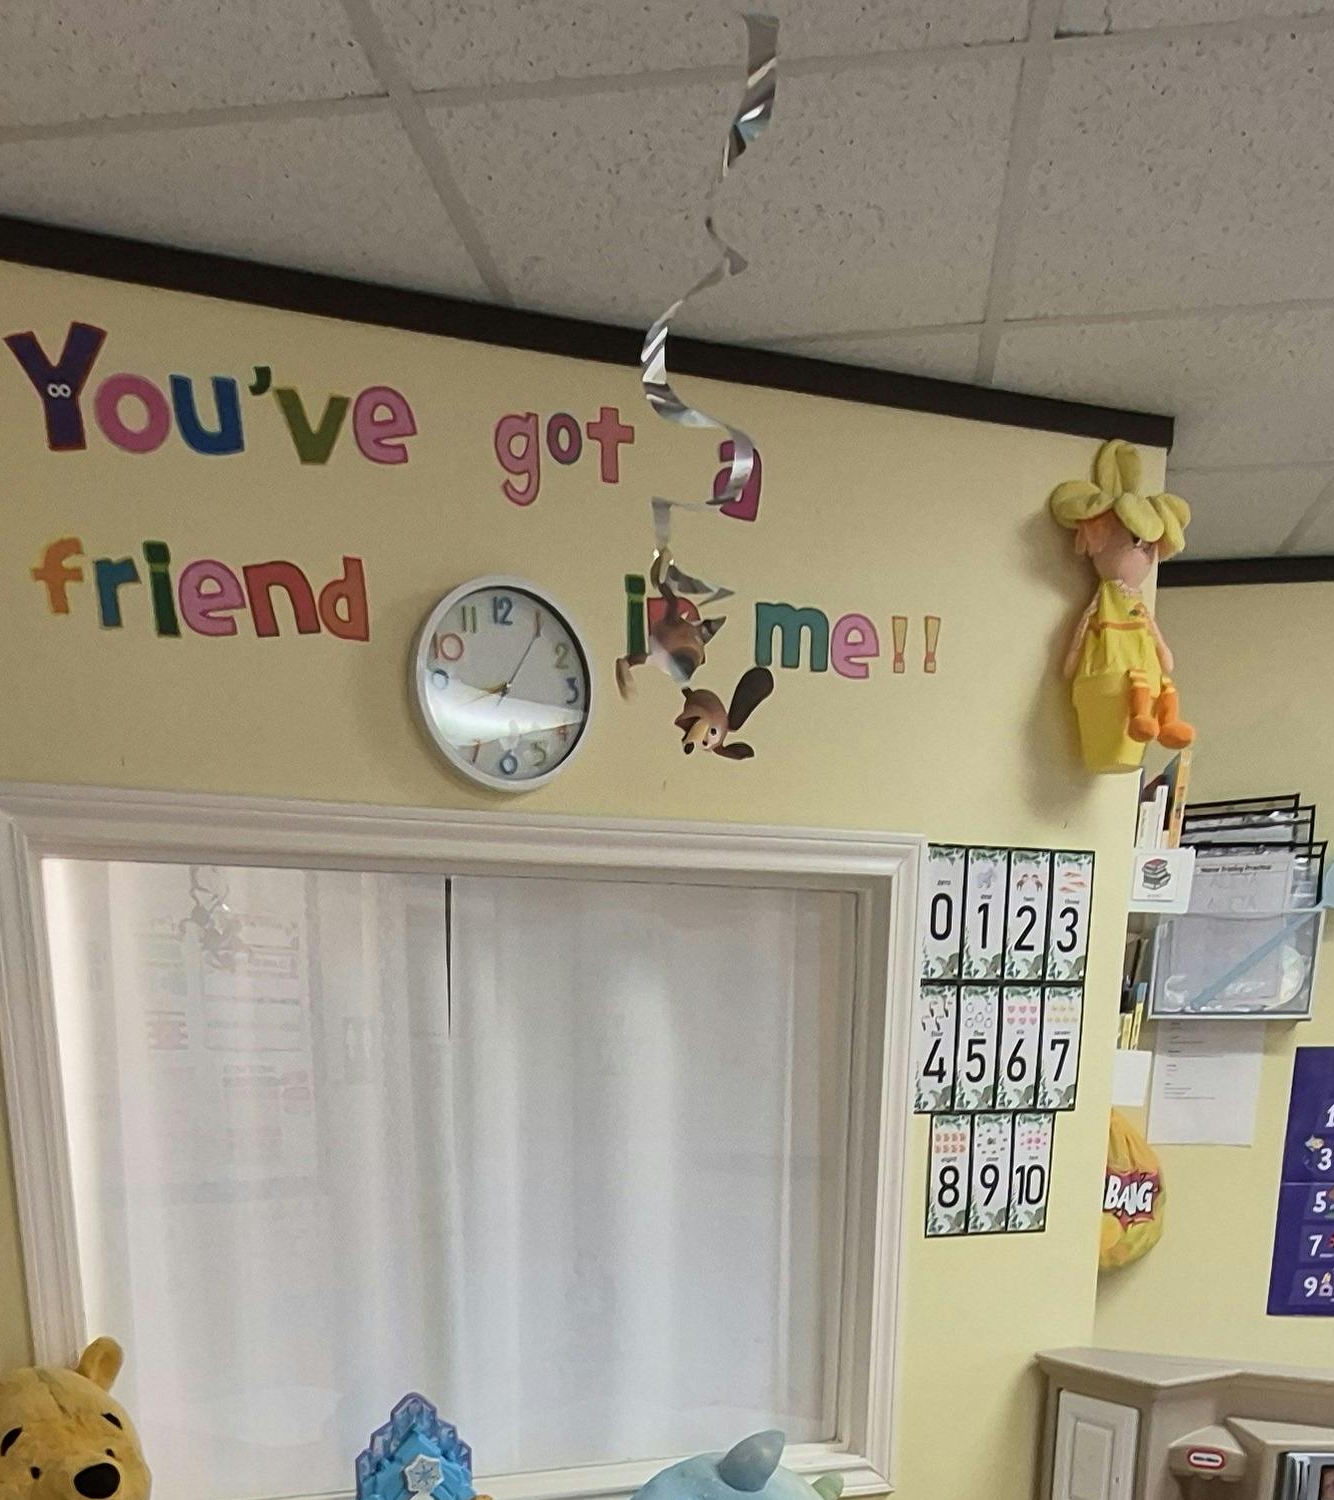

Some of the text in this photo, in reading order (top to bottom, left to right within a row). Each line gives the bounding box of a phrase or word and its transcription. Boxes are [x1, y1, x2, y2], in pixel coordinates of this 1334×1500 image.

[3, 320, 762, 522] You've got a
[31, 536, 370, 642] friend
[492, 596, 514, 627] 12
[462, 605, 478, 634] 11
[433, 632, 465, 661] 10
[554, 641, 570, 670] 2
[565, 677, 580, 705] 3
[930, 892, 953, 942] 0
[976, 902, 991, 950] 1
[1013, 904, 1038, 953] 2
[1056, 906, 1079, 954] 3
[923, 1038, 947, 1085] 4
[965, 1038, 987, 1085] 5
[1007, 1037, 1027, 1084] 6
[1050, 1037, 1071, 1083] 7
[1317, 1147, 1333, 1171] 3
[937, 1164, 960, 1210] 8
[979, 1163, 1001, 1208] 9
[1014, 1163, 1046, 1207] 10
[1312, 1191, 1328, 1214] 5
[1308, 1234, 1324, 1258] 7
[1303, 1276, 1319, 1299] 9
